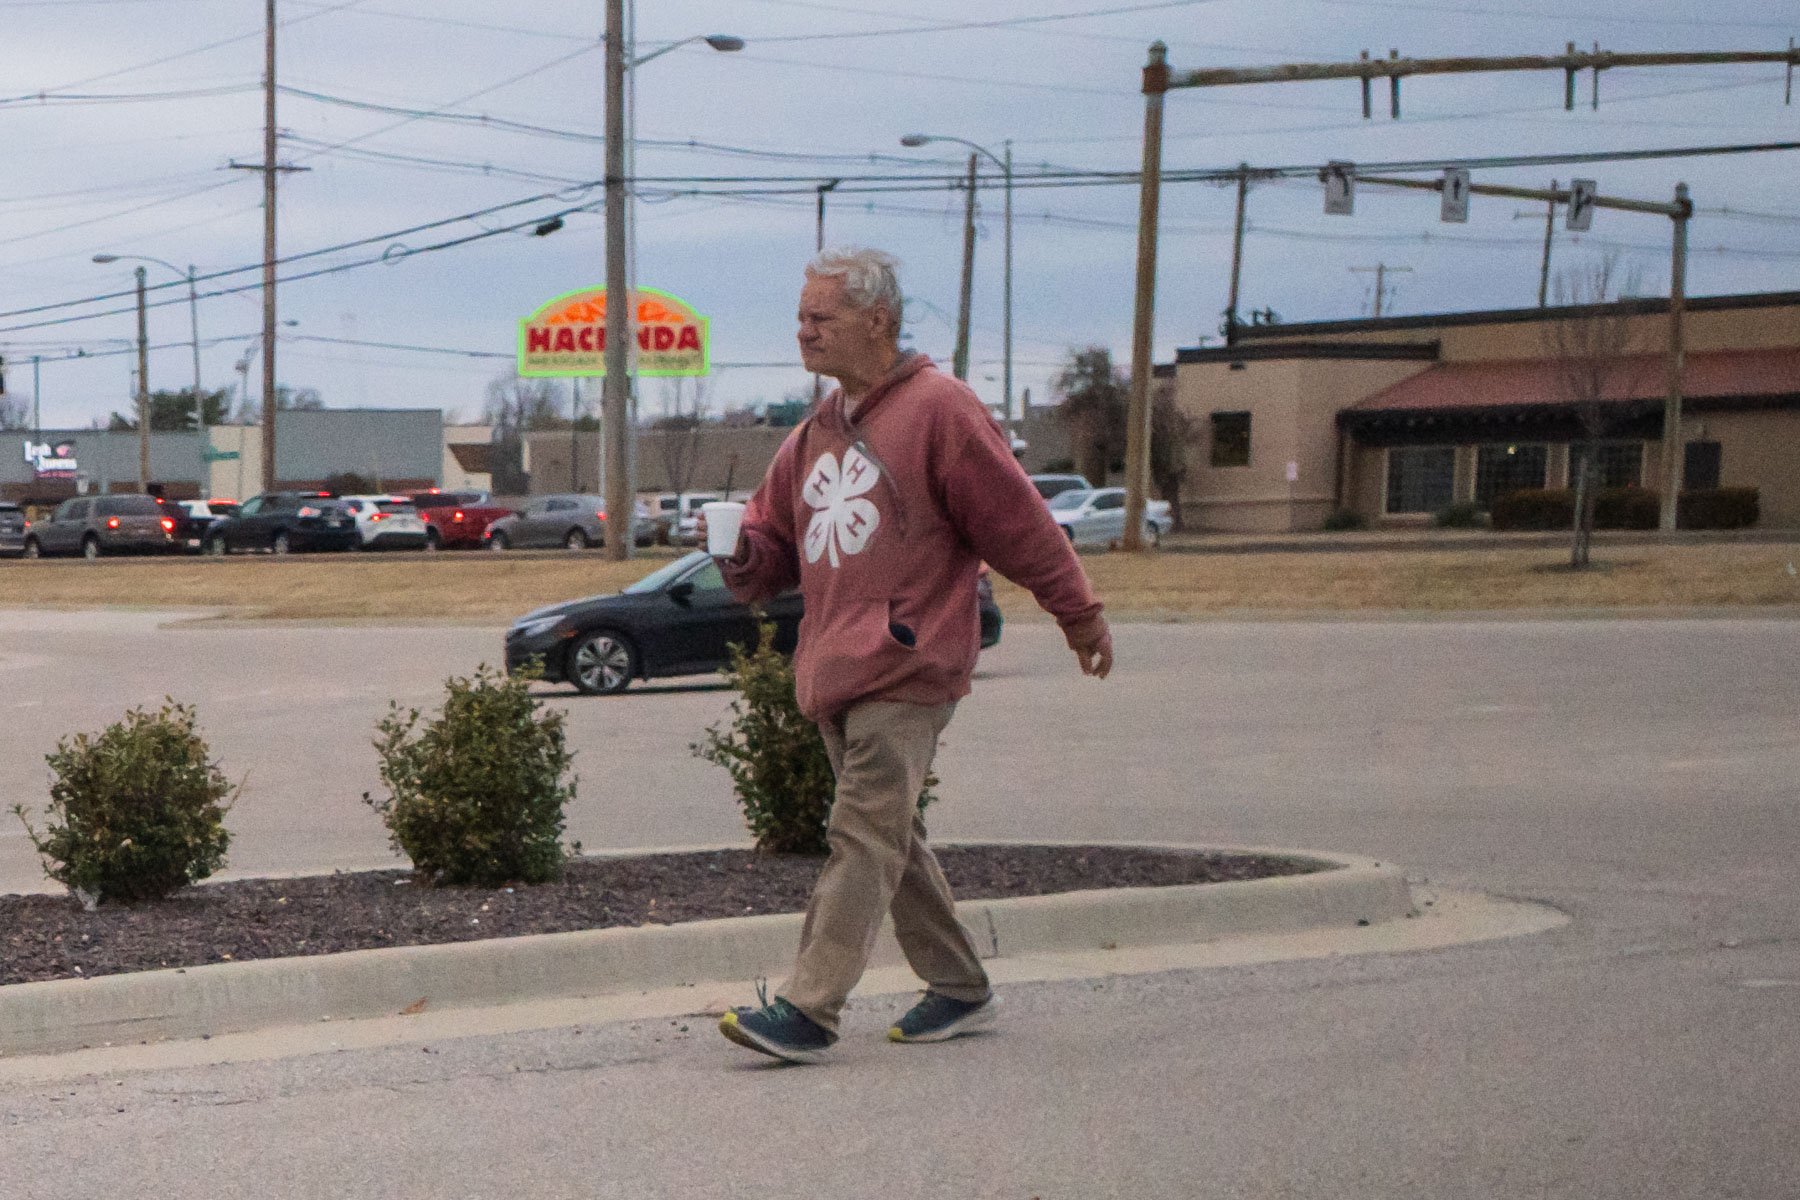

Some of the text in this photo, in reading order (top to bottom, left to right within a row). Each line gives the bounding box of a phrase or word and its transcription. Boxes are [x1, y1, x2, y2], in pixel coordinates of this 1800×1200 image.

[813, 470, 831, 495] H
[846, 457, 866, 484] H
[847, 511, 866, 537] H
